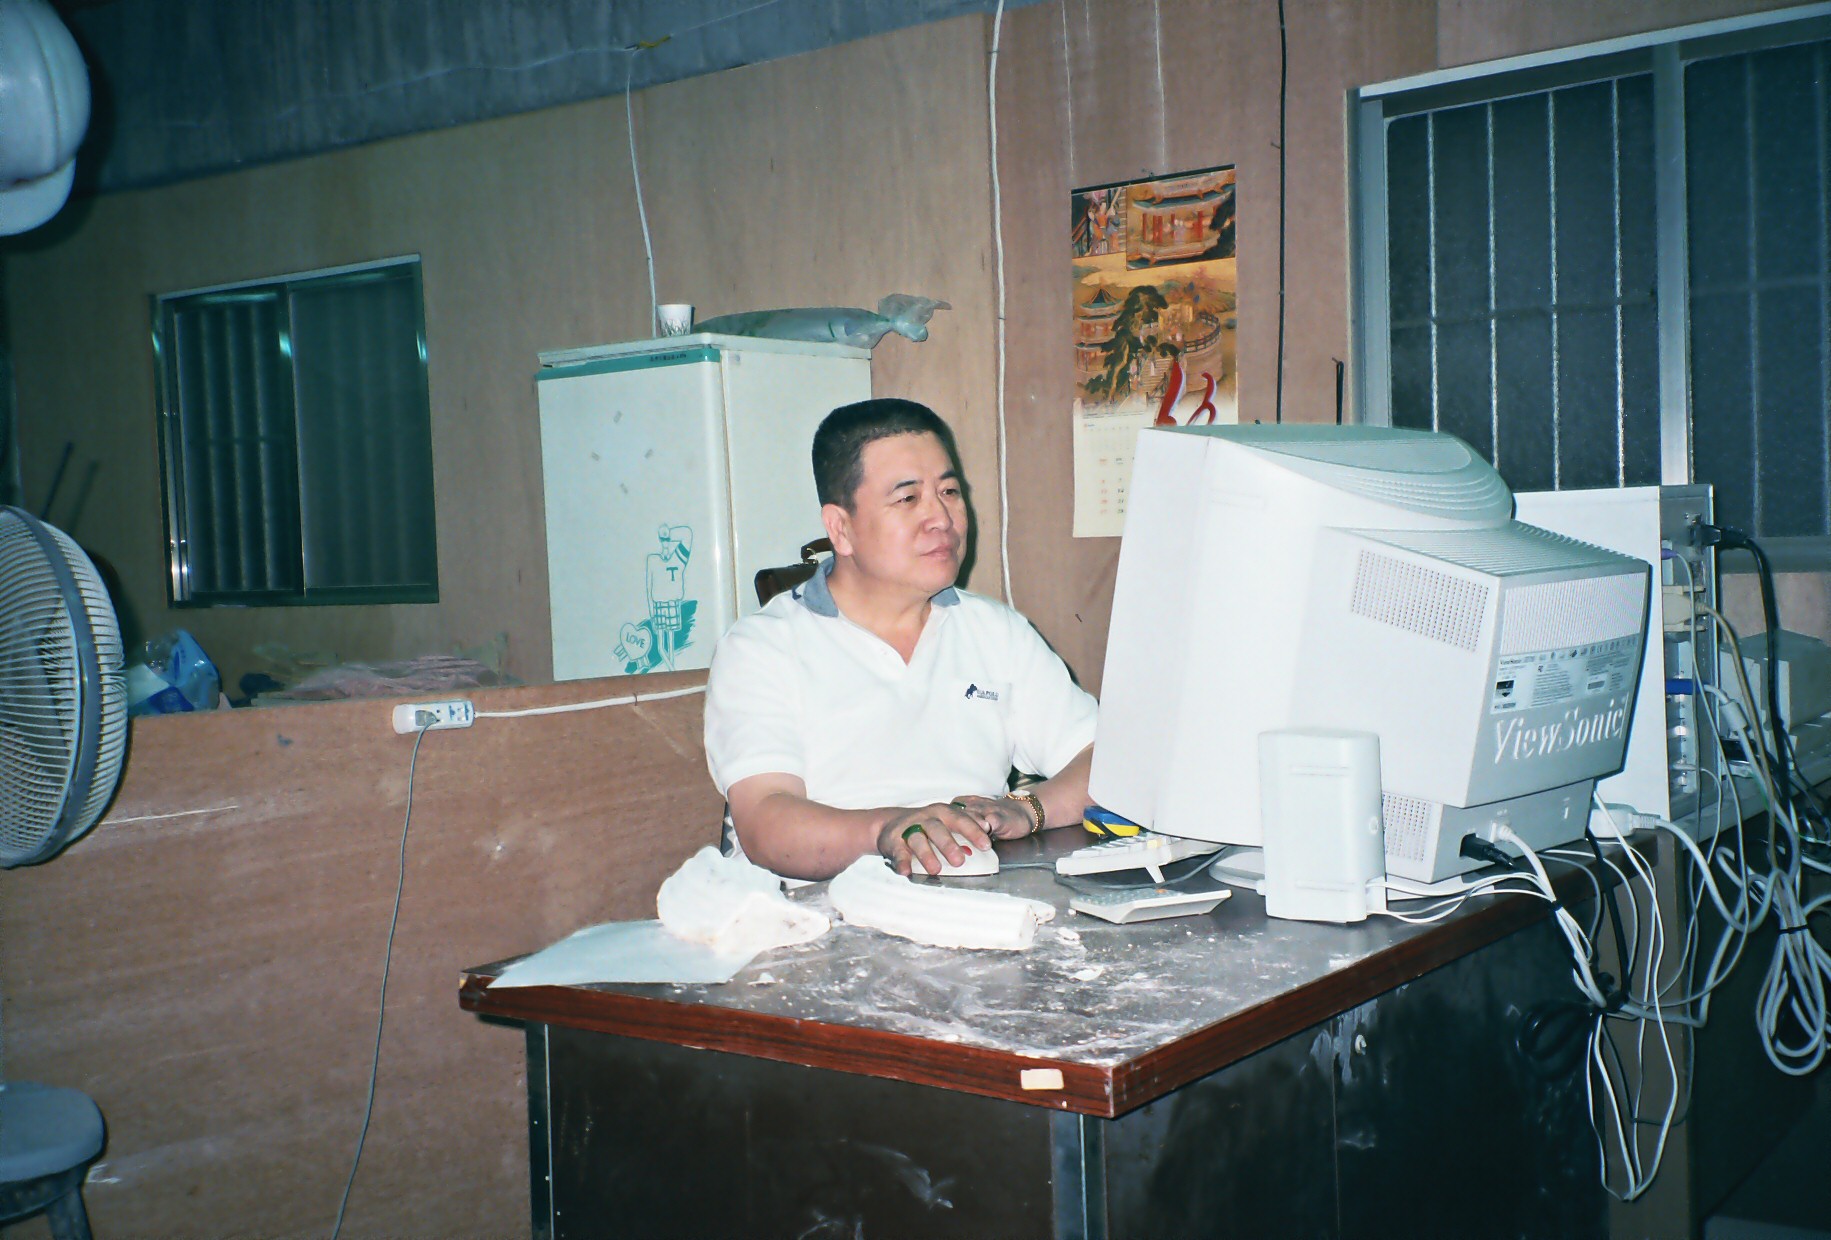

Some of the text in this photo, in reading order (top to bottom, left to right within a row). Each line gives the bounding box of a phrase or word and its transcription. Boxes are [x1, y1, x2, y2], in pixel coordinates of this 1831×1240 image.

[666, 566, 679, 581] T
[625, 632, 646, 649] LOVE
[1494, 698, 1624, 765] ViewSonic
